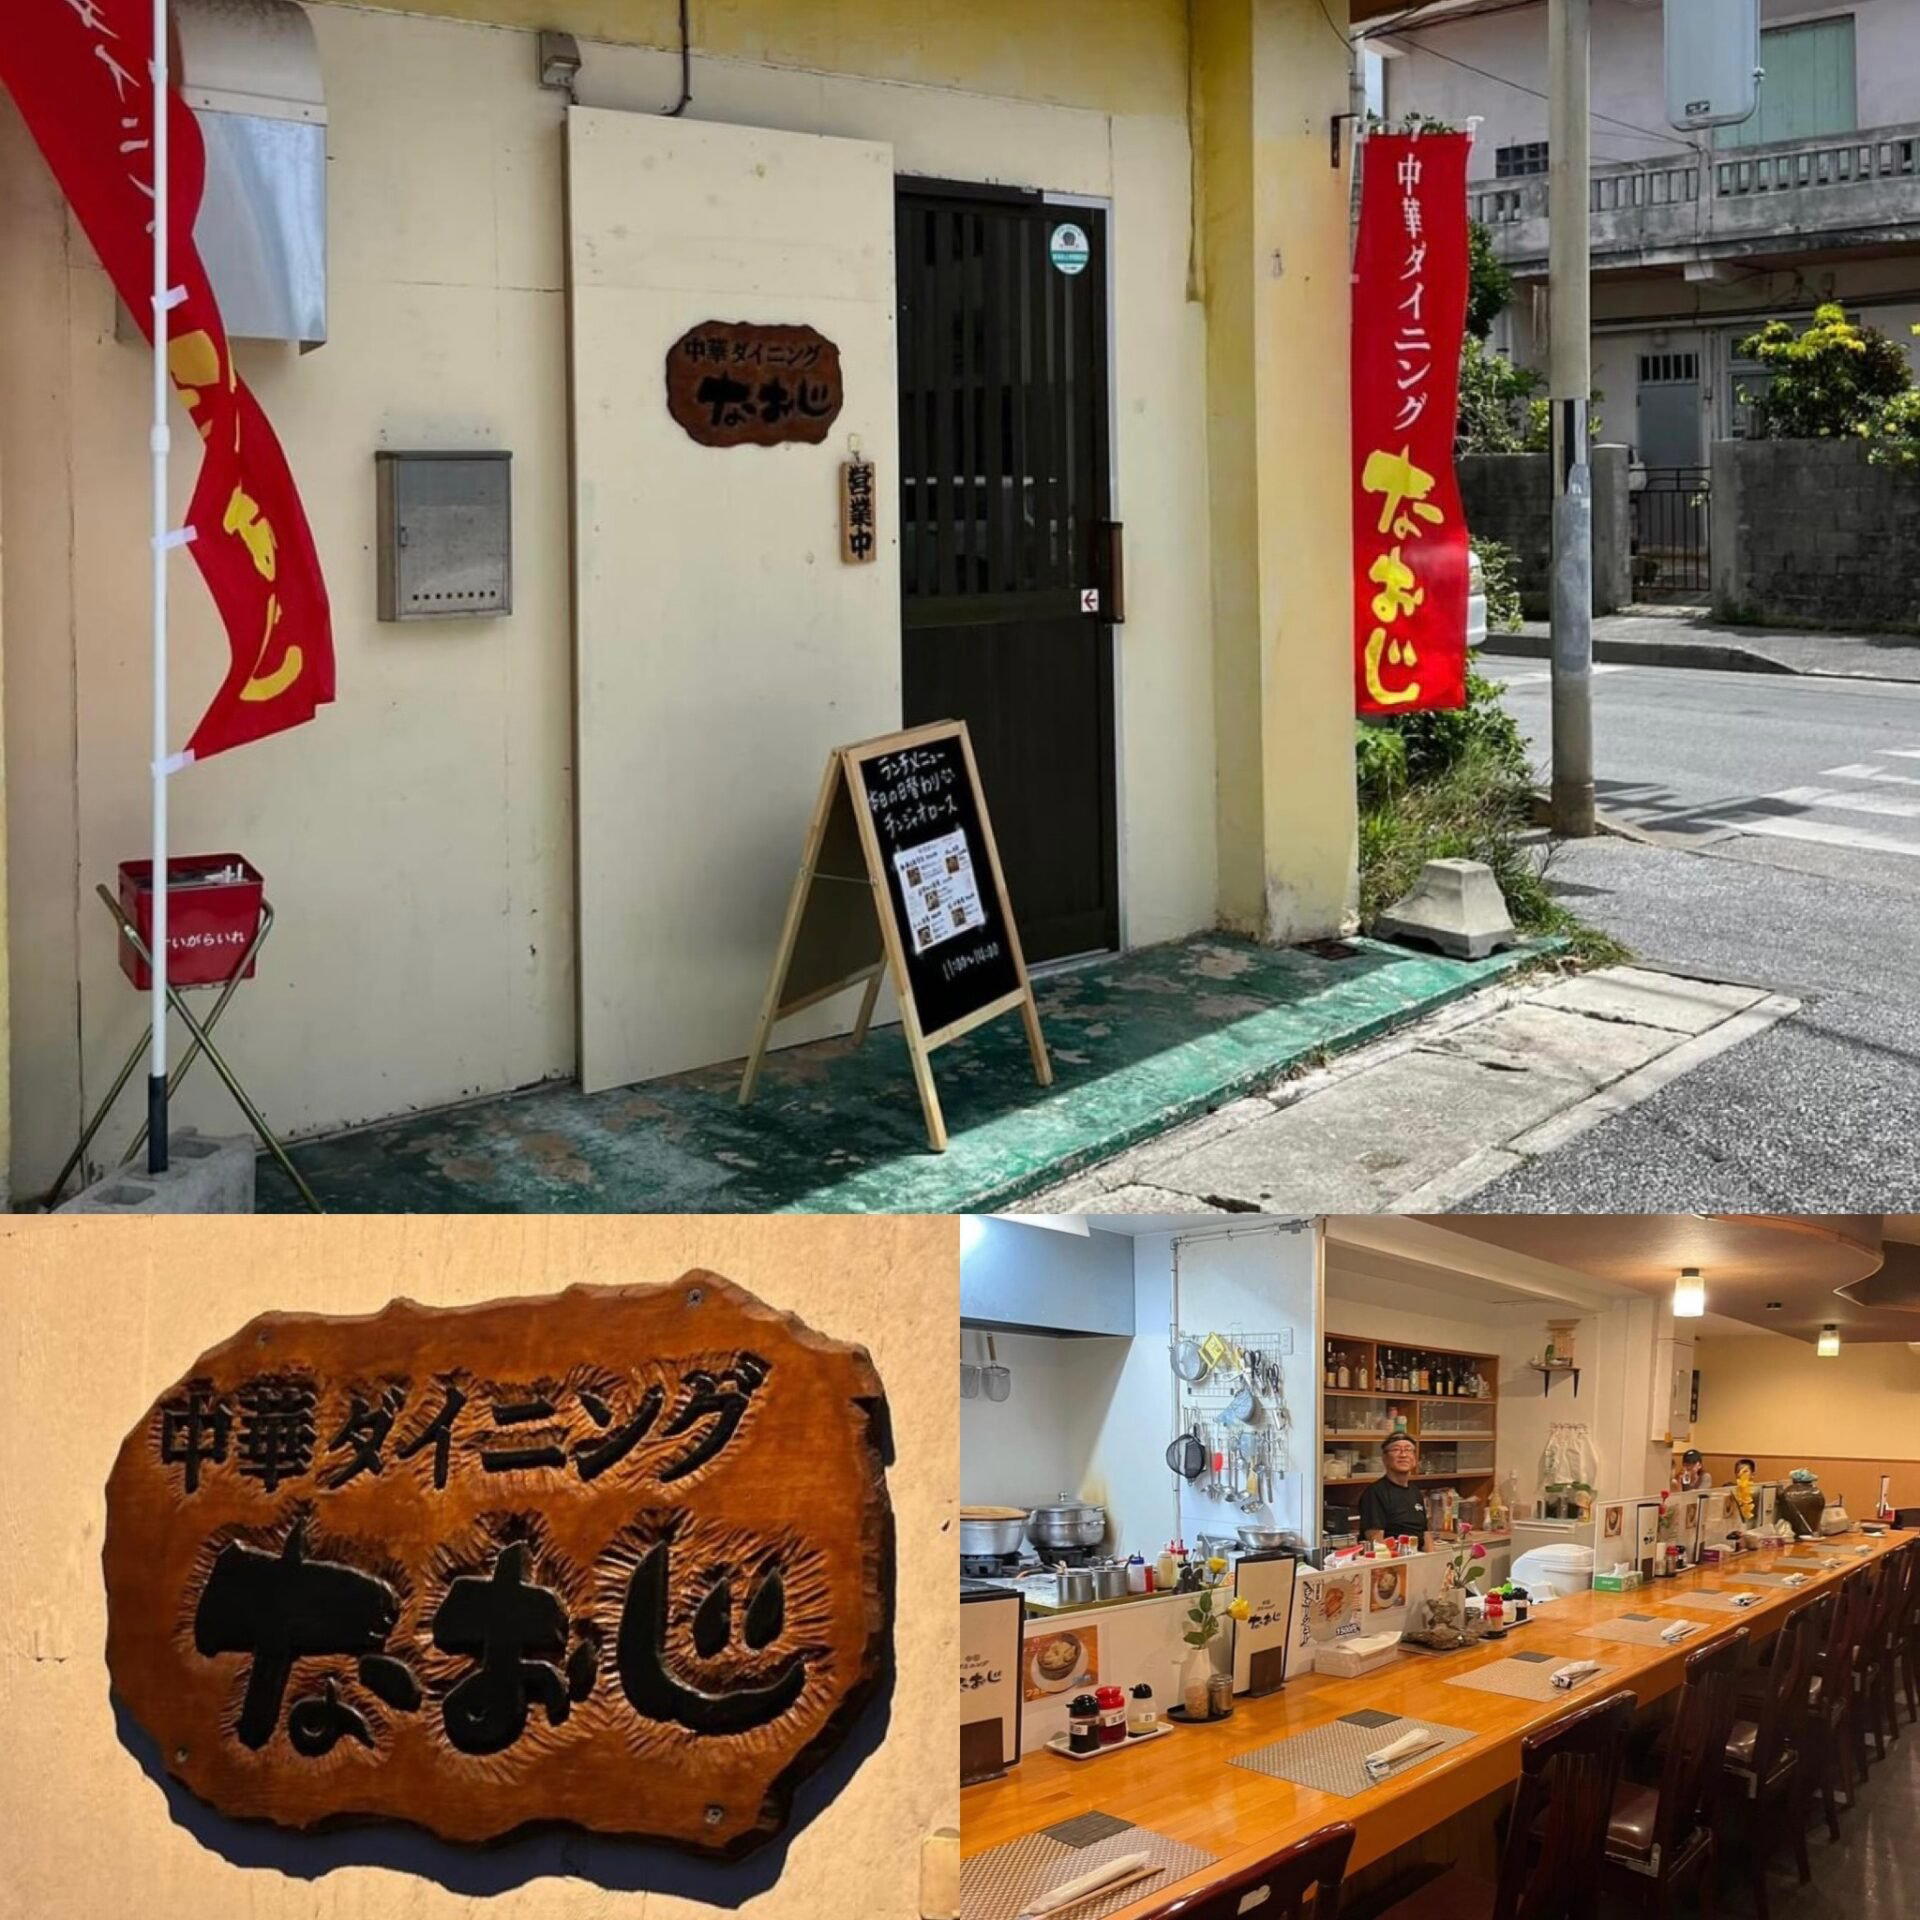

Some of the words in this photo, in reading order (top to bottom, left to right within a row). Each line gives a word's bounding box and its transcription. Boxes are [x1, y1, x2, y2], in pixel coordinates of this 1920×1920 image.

[1394, 153, 1431, 430] 中華ダイニング
[685, 337, 822, 367] 中華ダイニング
[697, 371, 829, 427] なおじ
[847, 464, 872, 561] 営業中
[1362, 444, 1444, 705] なおじ
[878, 752, 946, 781] ランチメニュー
[165, 930, 246, 949] いがらいれ
[160, 1350, 773, 1494] 中華ダイニング
[193, 1513, 807, 1756] なおじ
